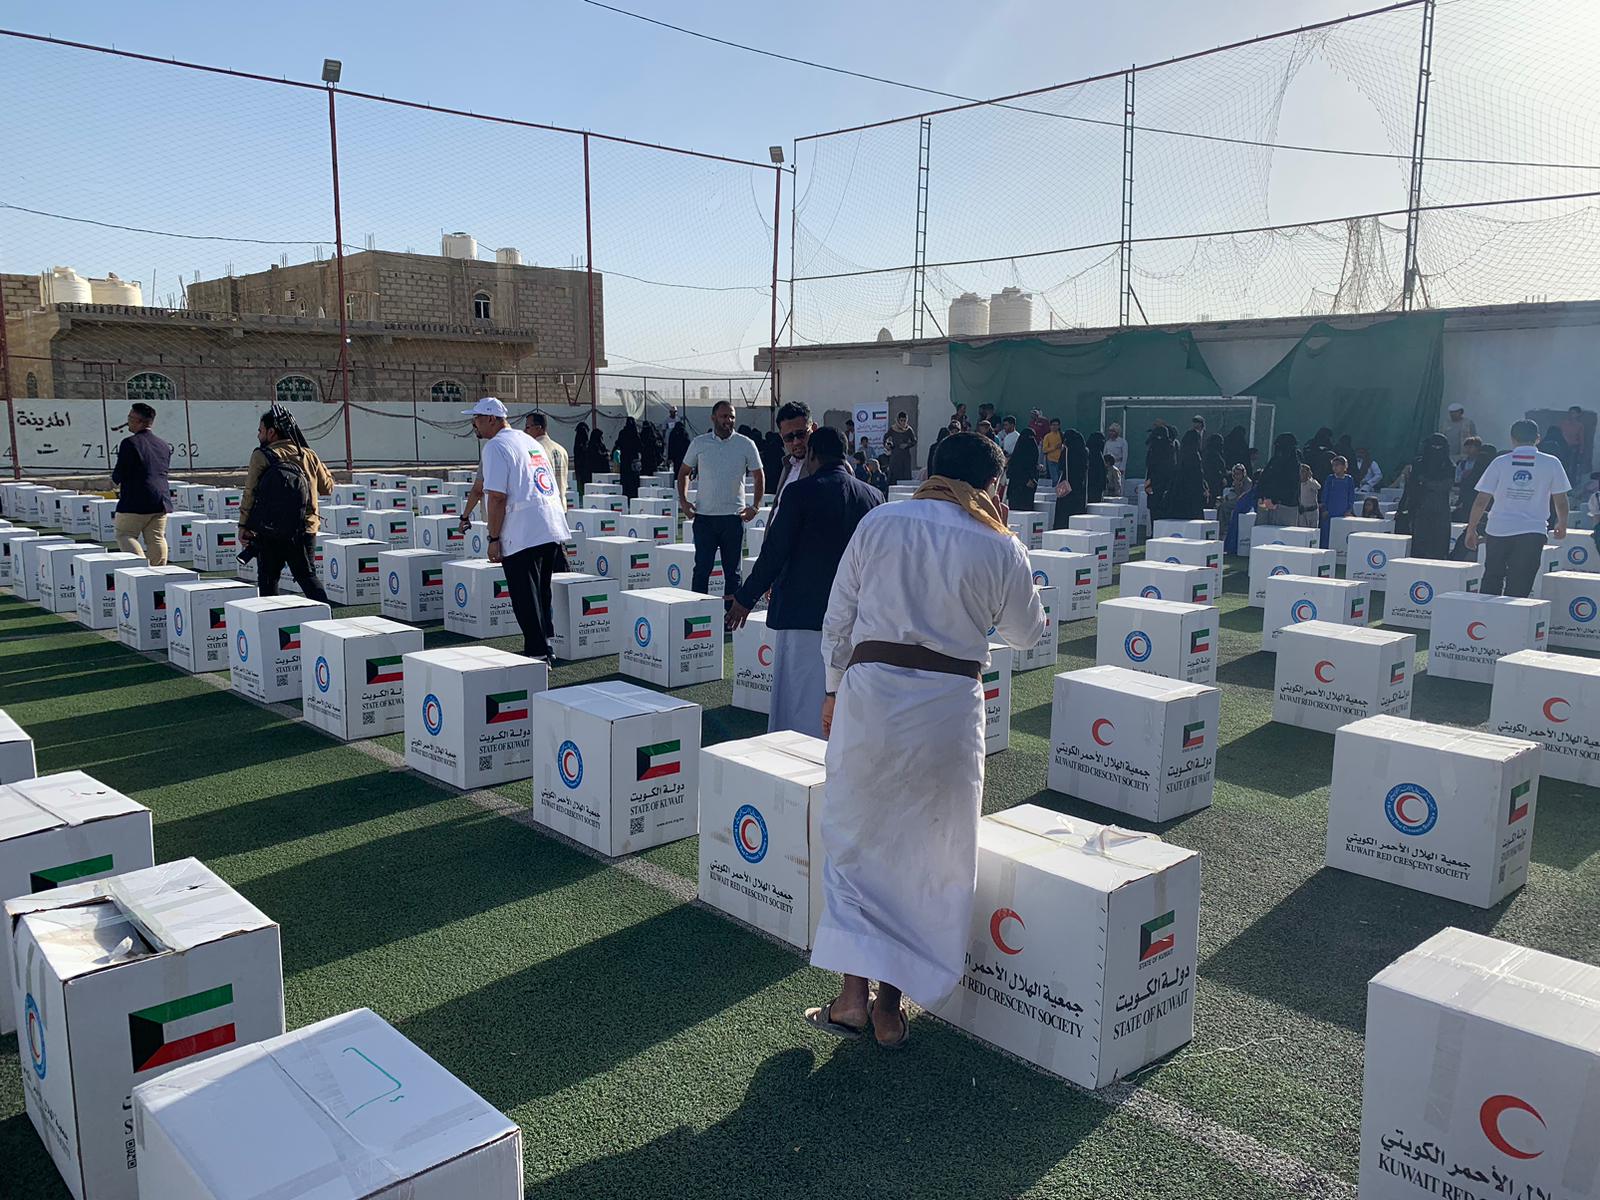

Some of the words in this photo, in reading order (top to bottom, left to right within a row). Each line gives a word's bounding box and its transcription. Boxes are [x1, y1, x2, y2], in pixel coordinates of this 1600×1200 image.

[1345, 694, 1368, 708] جمعية
[1497, 720, 1528, 734] الكويتي
[1528, 727, 1556, 739] الأحمر
[1557, 731, 1583, 745] الهلال
[479, 744, 498, 754] STATE
[498, 742, 507, 751] OF
[1056, 742, 1080, 756] الكويتي
[1544, 743, 1579, 757] RESCENT
[1104, 756, 1125, 770] الهلال
[1126, 760, 1150, 779] جمعية
[1055, 754, 1077, 769] KUWAIT
[1077, 762, 1090, 774] RED
[1090, 766, 1121, 784] CRESCENT
[1121, 776, 1150, 792] SOCIETY
[630, 787, 662, 802] الكويت
[662, 783, 685, 794] دولة
[630, 803, 651, 816] STATE
[650, 800, 660, 811] OF
[659, 794, 685, 809] KUWAIT
[1346, 833, 1378, 846] الكويتي
[1379, 842, 1410, 853] الأحمر
[1345, 843, 1376, 858] KUWAIT
[1376, 850, 1392, 862] RED
[1393, 855, 1435, 872] CRESCENT
[1434, 865, 1471, 881] SOCIETY
[1411, 848, 1438, 861] الهلال
[1440, 853, 1471, 870] جمعية
[709, 859, 731, 874] الكويتي
[709, 870, 730, 887] KUWAIT
[730, 880, 741, 892] RED
[741, 885, 769, 904] CRESCENT
[768, 897, 794, 915] SOCIETY
[752, 877, 771, 892] الهلال
[772, 884, 794, 903] جمعية
[972, 961, 1008, 982] الأحمر
[1162, 965, 1190, 988] دولة
[1009, 973, 1041, 999] الهلال
[1115, 976, 1161, 1012] الكويت
[967, 976, 987, 996] RED
[987, 986, 1039, 1020] CRESCENT
[1037, 1008, 1085, 1039] SOCIETY
[1043, 984, 1084, 1018] جمعية
[1112, 1014, 1142, 1040] STATE
[1142, 1008, 1157, 1026] OF
[1156, 987, 1190, 1018] KUWAIT
[1380, 1128, 1446, 1166] الكويتي
[1378, 1152, 1441, 1194] KUWAIT
[1447, 1165, 1514, 1195] الأحمر
